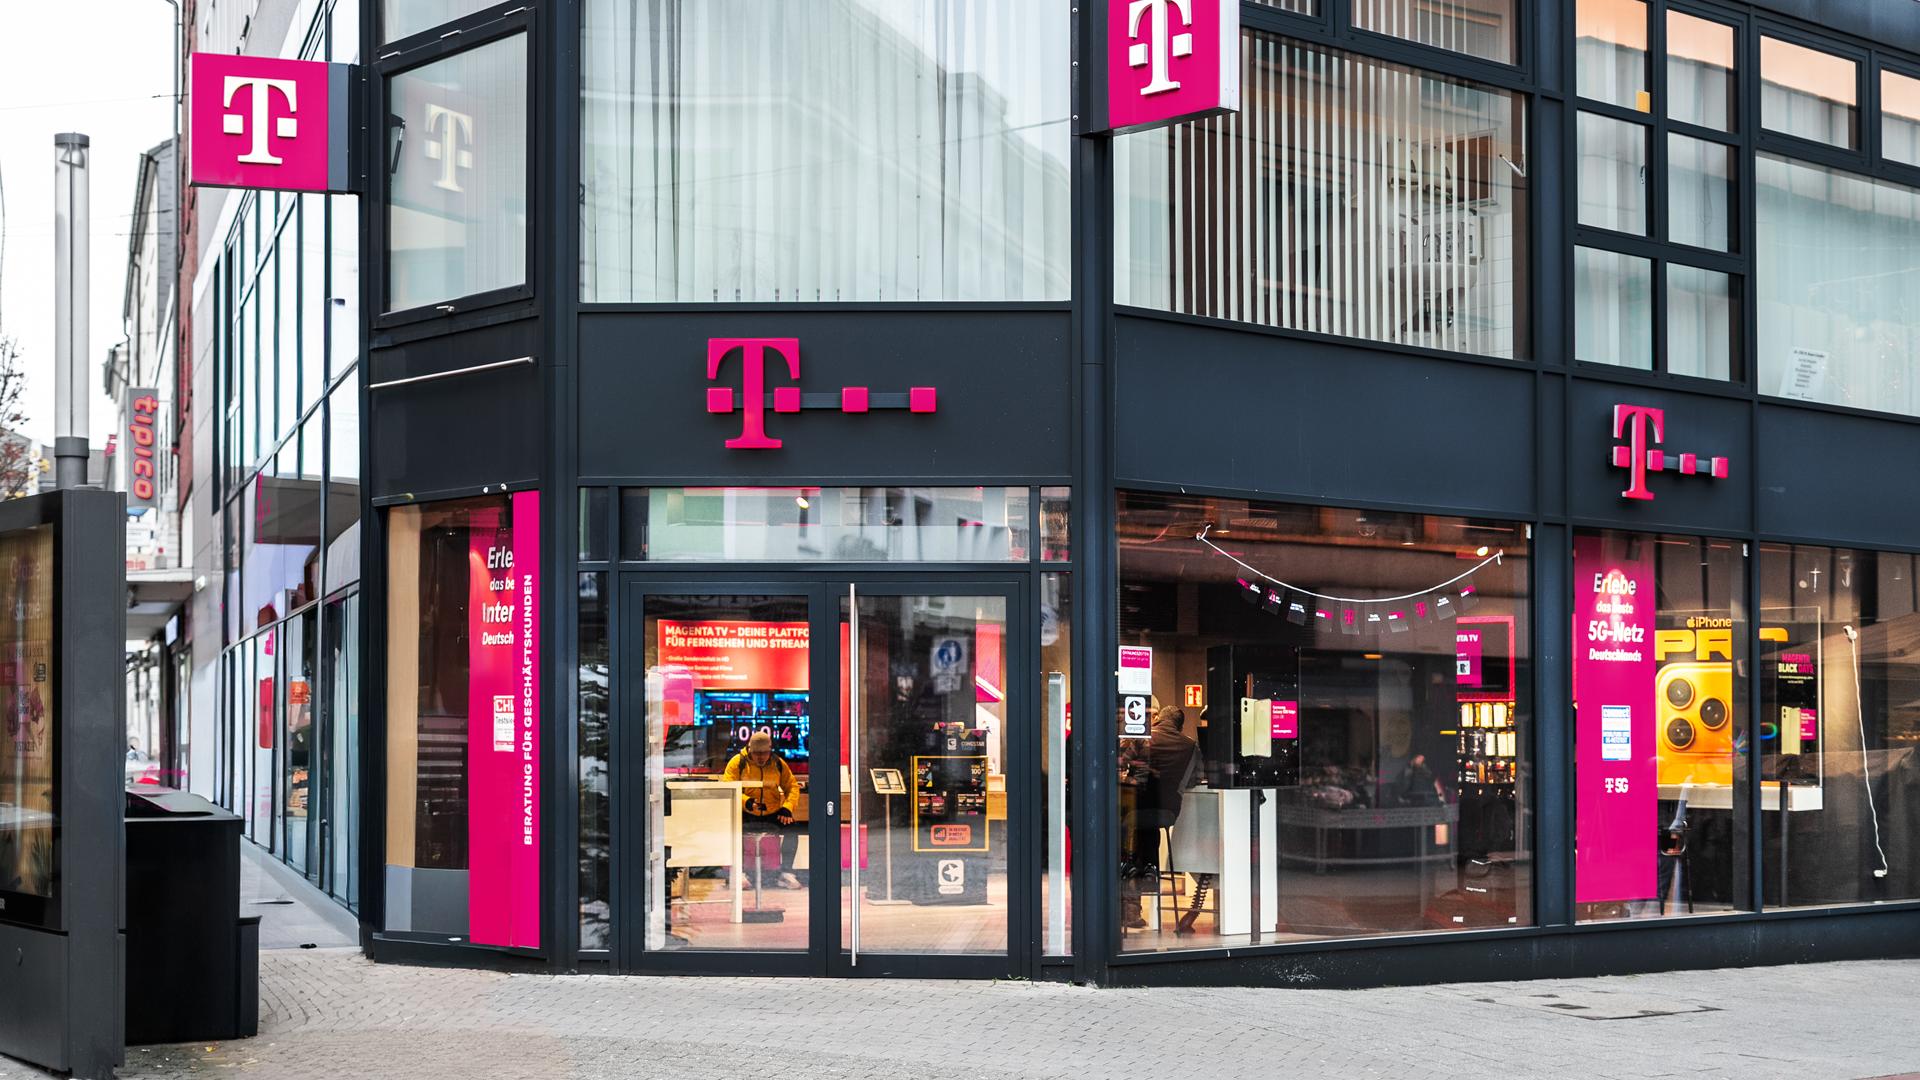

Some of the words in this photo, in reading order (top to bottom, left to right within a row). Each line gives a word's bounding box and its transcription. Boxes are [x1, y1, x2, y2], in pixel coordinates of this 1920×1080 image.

[1127, 0, 1193, 96] T
[222, 75, 298, 165] T
[129, 395, 158, 500] tipico
[487, 546, 515, 569] Erle
[490, 578, 504, 591] das
[1593, 572, 1637, 595] Erlebe
[665, 625, 714, 637] MAGENTA
[715, 627, 728, 637] TV
[738, 628, 767, 637] DEINE
[1588, 620, 1645, 643] 5G-Netz
[1695, 616, 1732, 628] iPhone
[665, 636, 685, 647] FÜR
[687, 638, 745, 649] FERNSEHEN
[746, 639, 767, 649] UND
[1469, 634, 1478, 642] TV
[522, 574, 533, 728] GESCHÄFTSKUNDEN
[1588, 648, 1642, 662] Deutschlands
[1778, 662, 1798, 673] BLACK
[522, 730, 533, 761] FÜR
[1614, 777, 1629, 793] 5G
[523, 764, 533, 845] BERATUNG
